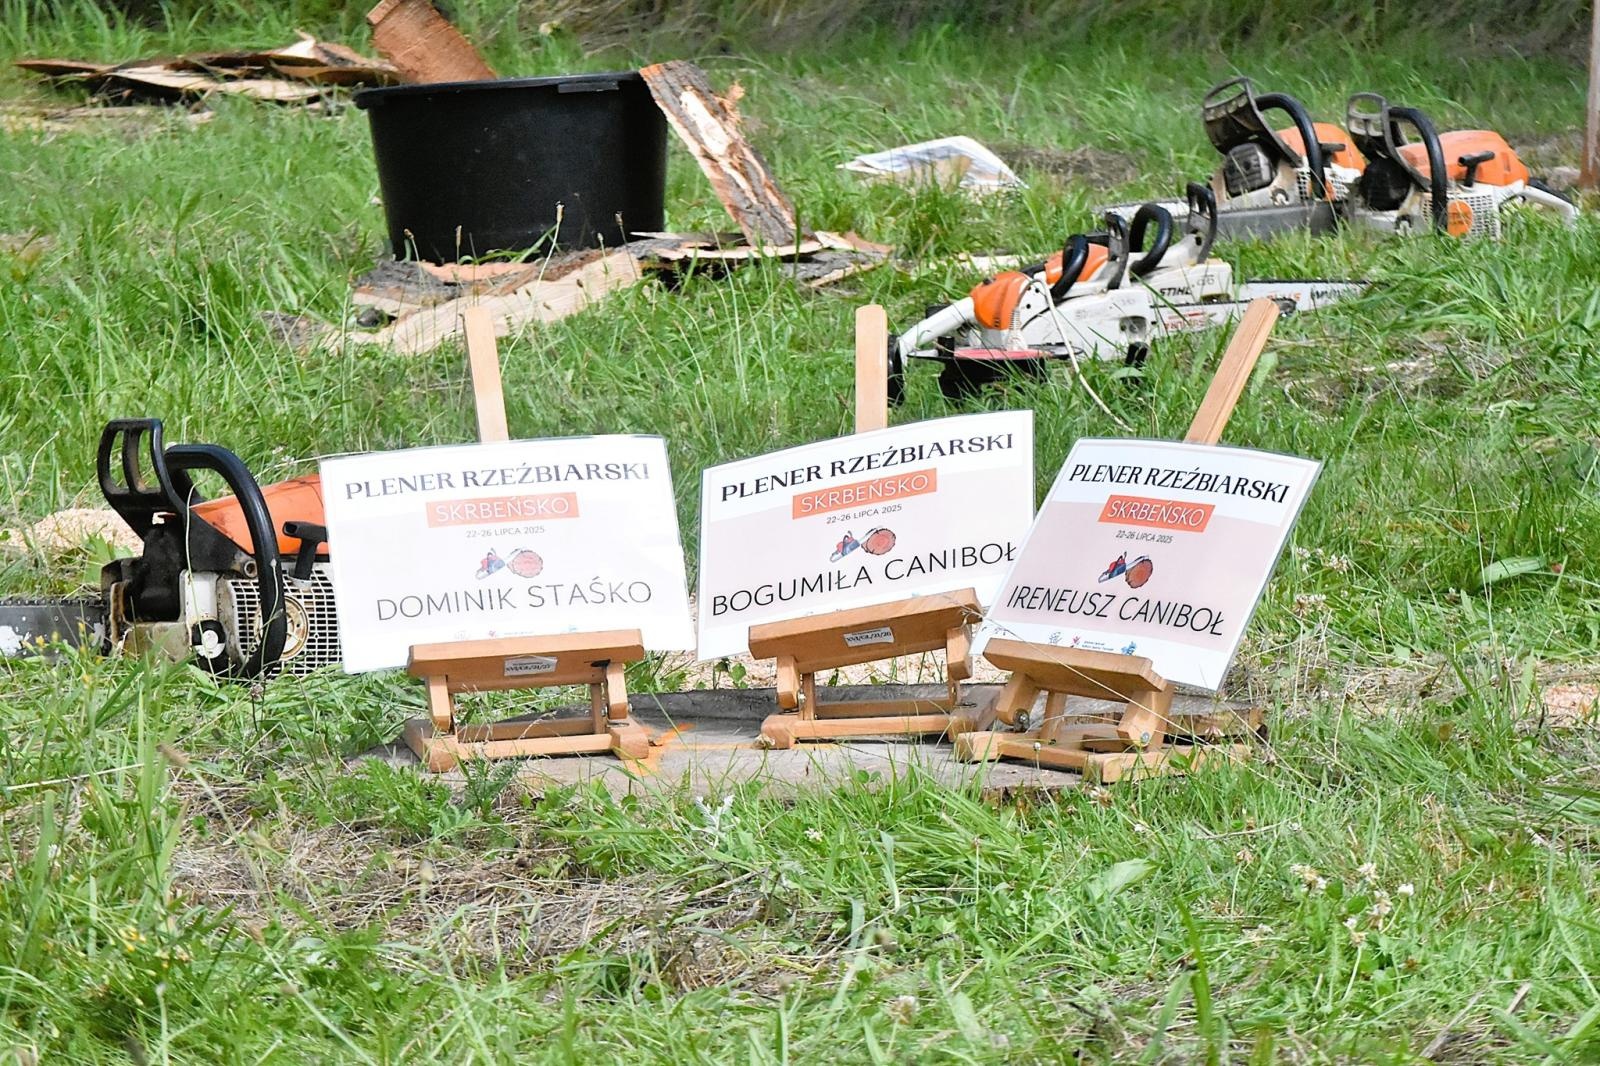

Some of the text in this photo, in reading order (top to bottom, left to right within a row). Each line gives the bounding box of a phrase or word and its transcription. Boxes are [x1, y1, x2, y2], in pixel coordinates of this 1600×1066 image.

[346, 462, 650, 500] PLENER RZEŹBIARSKI
[721, 433, 1013, 502] PLENER RZEŹBIARSKI
[1069, 464, 1290, 503] PLENER RZEŹBIARSKI
[435, 496, 569, 523] SKRBEŃSKO
[801, 474, 928, 513] SKRBEŃSKO
[466, 525, 545, 538] 22-26 LIPCA 2025
[826, 504, 903, 524] 22-26 LIPCA 2025
[1107, 499, 1206, 527] SKRBEŃSKO
[1135, 531, 1156, 542] LIPCA
[1156, 534, 1174, 543] 2025
[712, 542, 1017, 616] BOGUMIŁA CANIBOŁ
[377, 577, 652, 621] DOMINIK STAŚKO
[1007, 585, 1225, 637] IRENEUSZ CANIBOŁ
